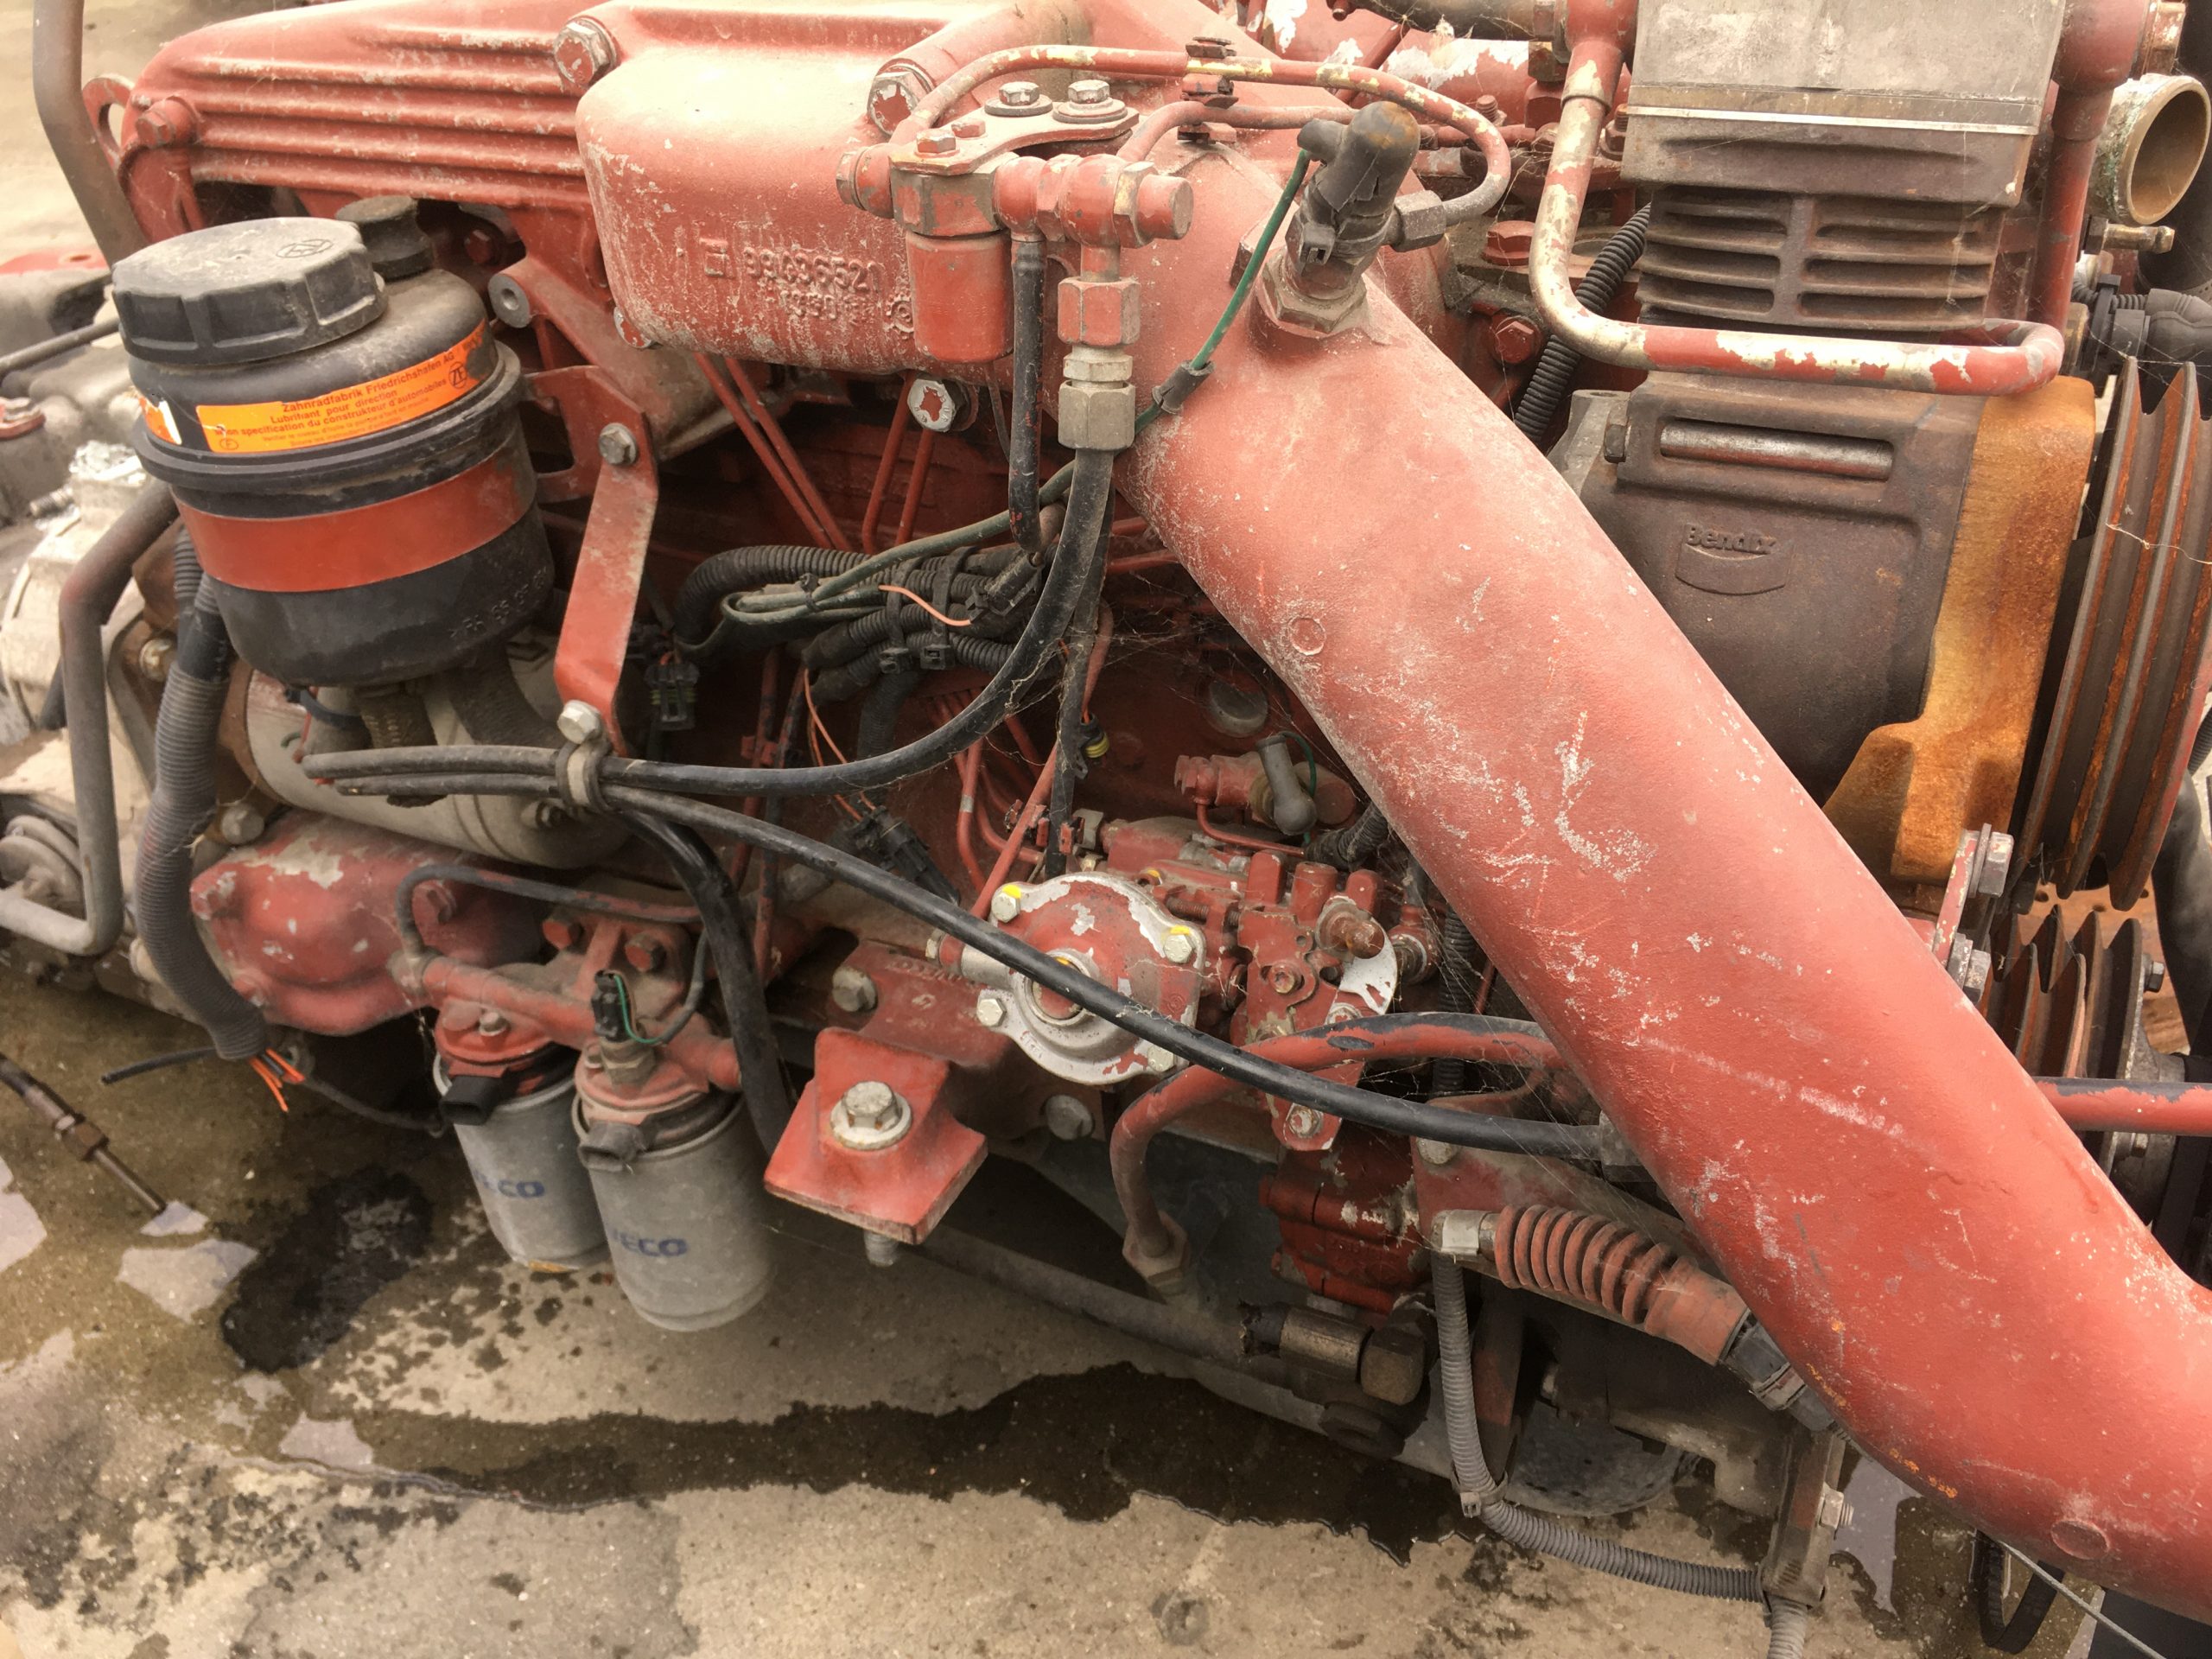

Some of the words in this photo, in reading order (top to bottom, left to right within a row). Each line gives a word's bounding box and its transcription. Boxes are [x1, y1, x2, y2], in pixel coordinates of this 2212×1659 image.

[283, 387, 363, 413] Zahnradfabrik
[365, 361, 442, 395] Friedrichshafen
[442, 351, 455, 365] AG
[270, 409, 321, 424] Lubrifiant
[327, 404, 350, 416] pour
[355, 390, 397, 408] direction
[307, 419, 321, 428] du
[323, 404, 387, 424] construkteur
[1684, 522, 1777, 555] Bendix
